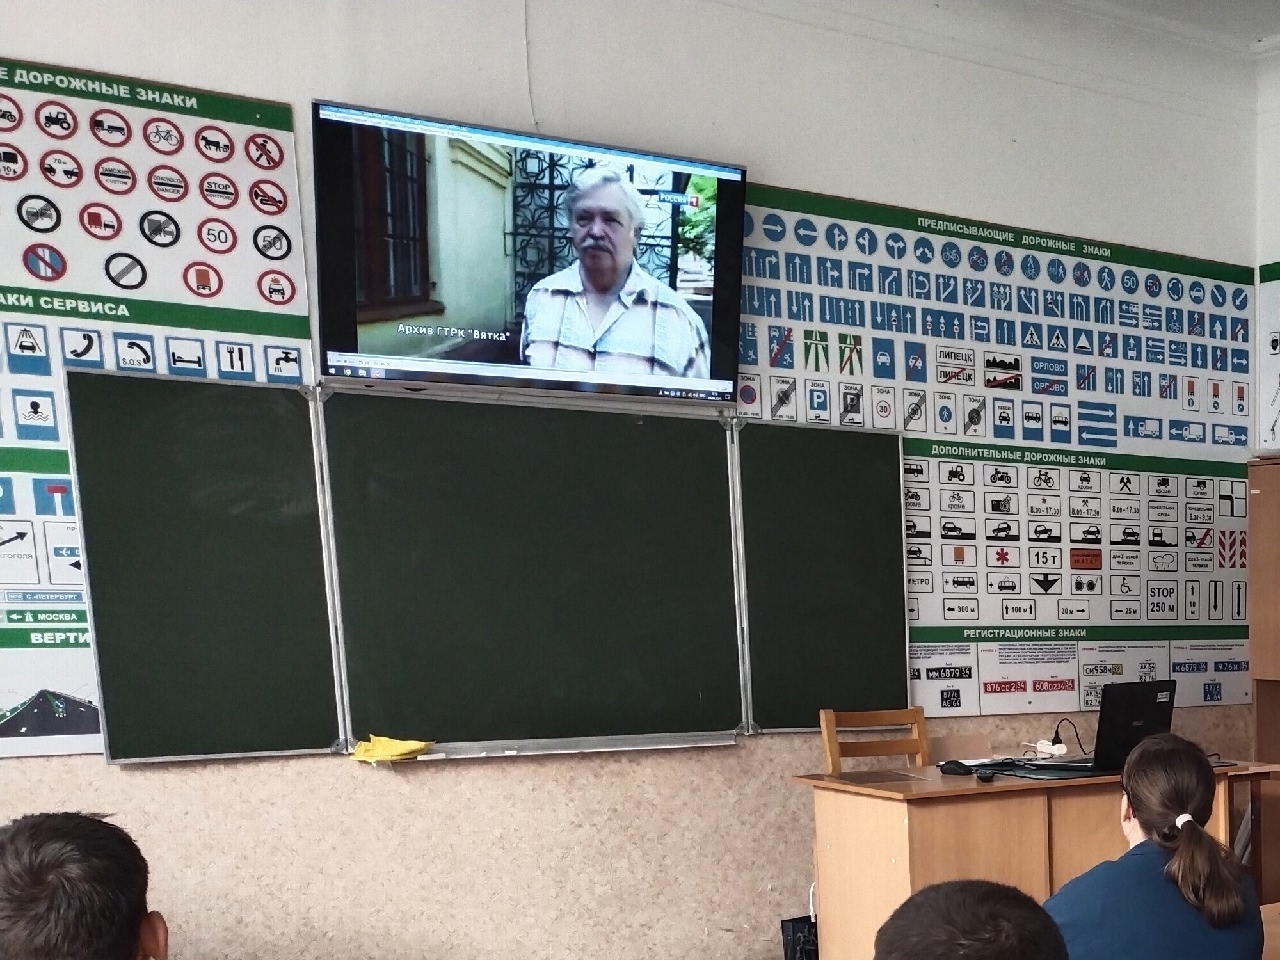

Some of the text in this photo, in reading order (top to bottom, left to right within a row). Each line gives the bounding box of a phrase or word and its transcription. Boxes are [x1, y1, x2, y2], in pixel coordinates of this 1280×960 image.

[14, 69, 131, 98] ДОРОЖНЫЕ
[135, 87, 198, 109] ЗНАКИ
[206, 181, 231, 191] STOP
[206, 229, 229, 244] 50
[917, 216, 1111, 257] ПРЕДПИСЫВАЮЩИЕ ДОРОЖНЫЕ ЗНАКИ
[1124, 276, 1137, 289] 50
[40, 297, 131, 317] СЕРВИСА
[397, 323, 511, 341] Архив ГТРК "Вятка"
[121, 357, 144, 367] S.O.S.
[939, 350, 973, 363] ЛИПЕЦК
[1033, 361, 1065, 372] ОРЛОВО
[879, 405, 888, 414] 30
[931, 444, 1106, 466] ДОПОЛНИТЕЛЬНЫЕ ДОРОЖНЫЕ ЗНАКИ
[1034, 551, 1048, 565] 15
[1150, 587, 1175, 598] STOP
[1150, 602, 1166, 613] 250
[37, 613, 78, 621] МОСКВА
[963, 628, 1087, 639] РЕГИСТРАЦИОННЫЕ ЗНАКИ
